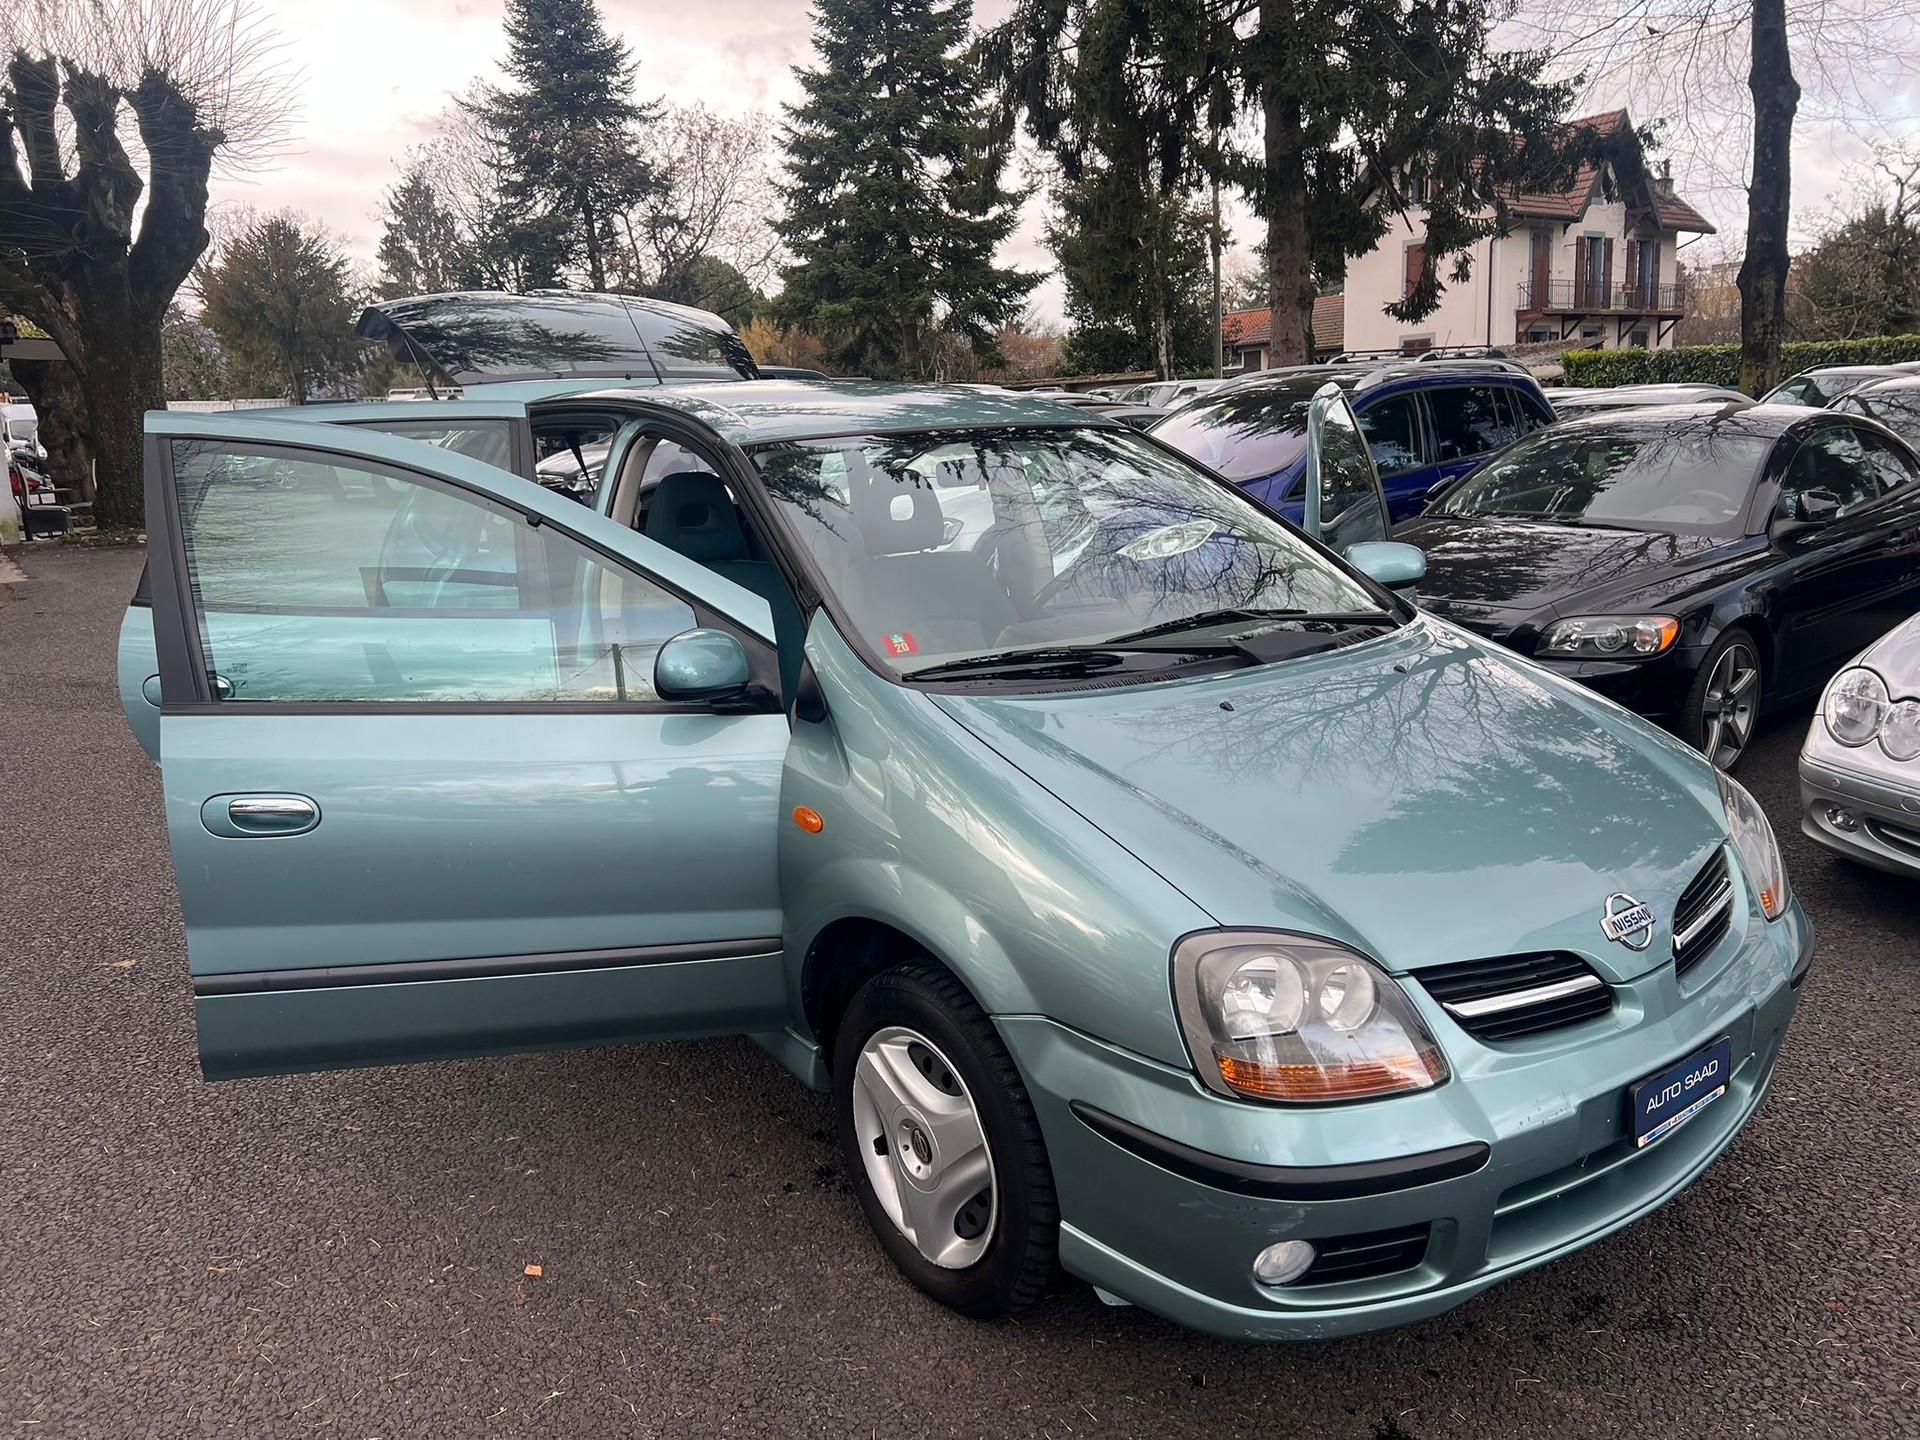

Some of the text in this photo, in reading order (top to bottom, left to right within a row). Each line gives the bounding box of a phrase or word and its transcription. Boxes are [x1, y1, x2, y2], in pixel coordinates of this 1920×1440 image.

[893, 642, 910, 653] 20
[1611, 907, 1652, 934] NISSAN
[1645, 1081, 1682, 1115] AUTO
[1684, 1059, 1719, 1090] SAAD
